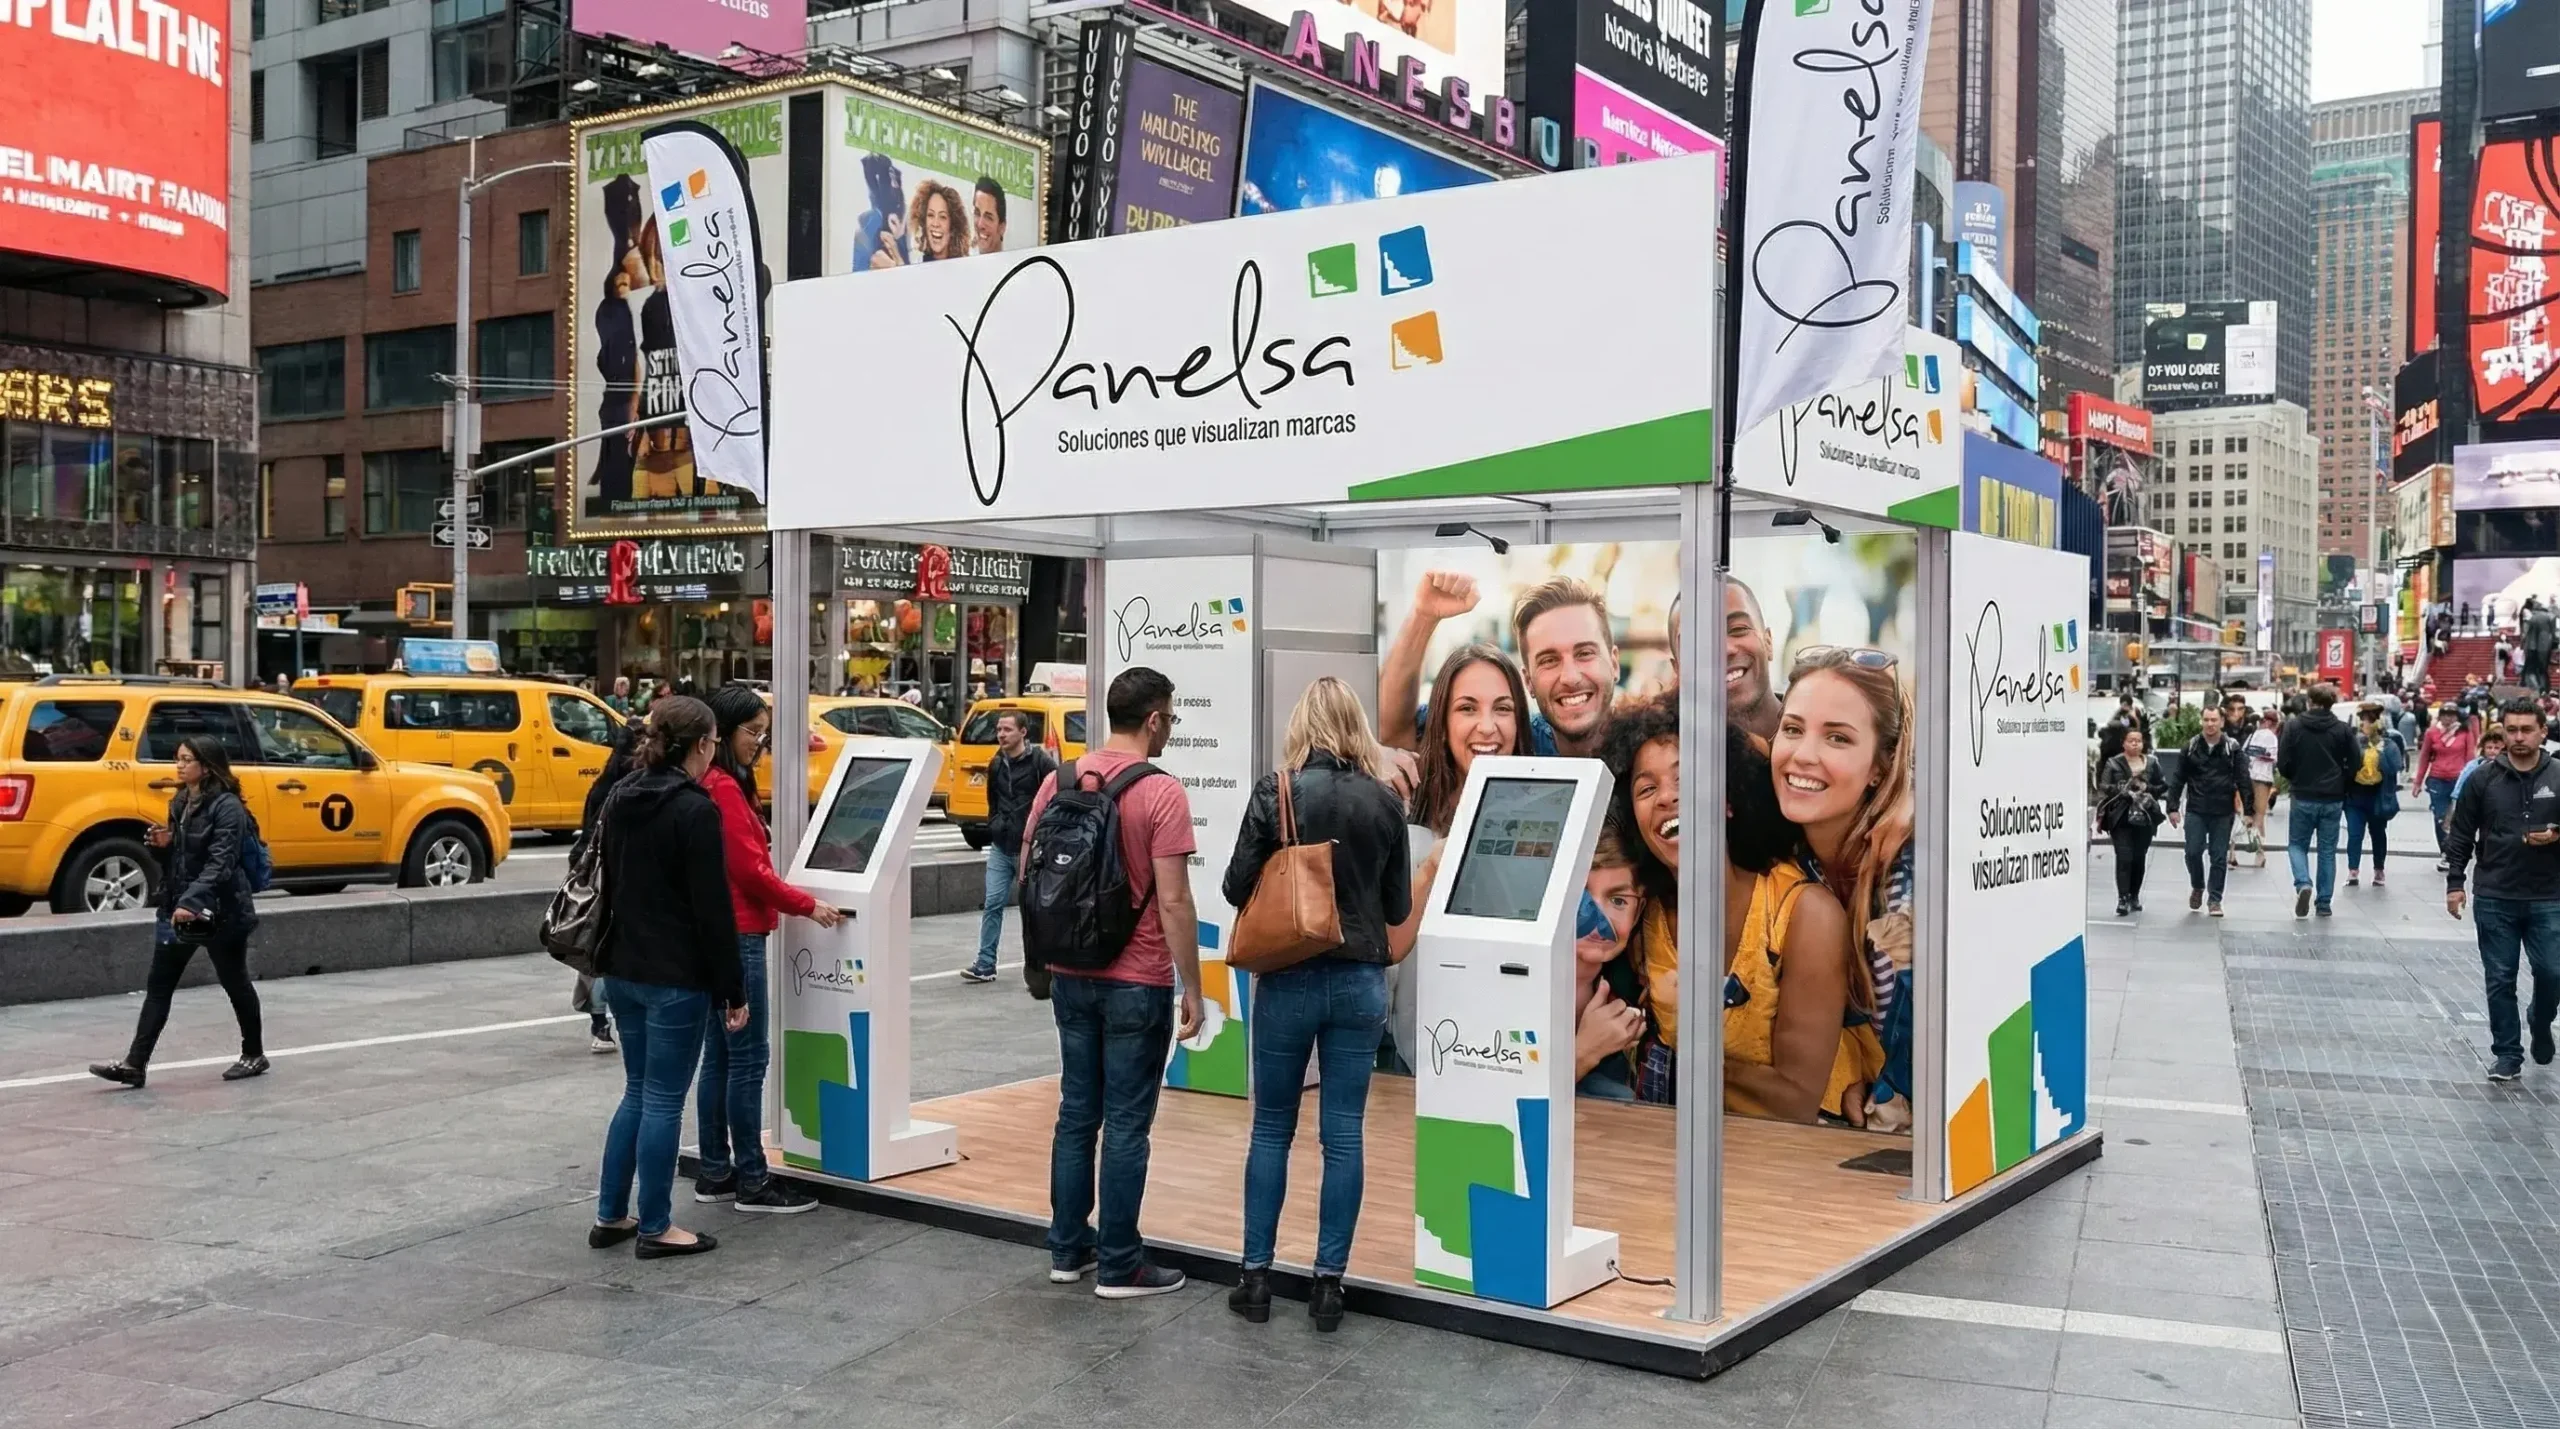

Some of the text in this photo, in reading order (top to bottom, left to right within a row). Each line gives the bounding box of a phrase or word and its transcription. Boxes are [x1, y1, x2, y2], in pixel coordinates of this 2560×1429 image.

[1172, 93, 1199, 122] THE
[945, 255, 1356, 507] Panelsa
[1057, 412, 1357, 453] Soluciones que visualizan marcas
[1113, 595, 1224, 663] Panelsa
[1965, 600, 2065, 768] Panelsa
[327, 801, 347, 828] T
[1979, 796, 2064, 840] Soluciones que
[1972, 846, 2029, 891] visualizan
[789, 948, 854, 996] Panelsa
[1424, 1018, 1522, 1076] Panelsa
